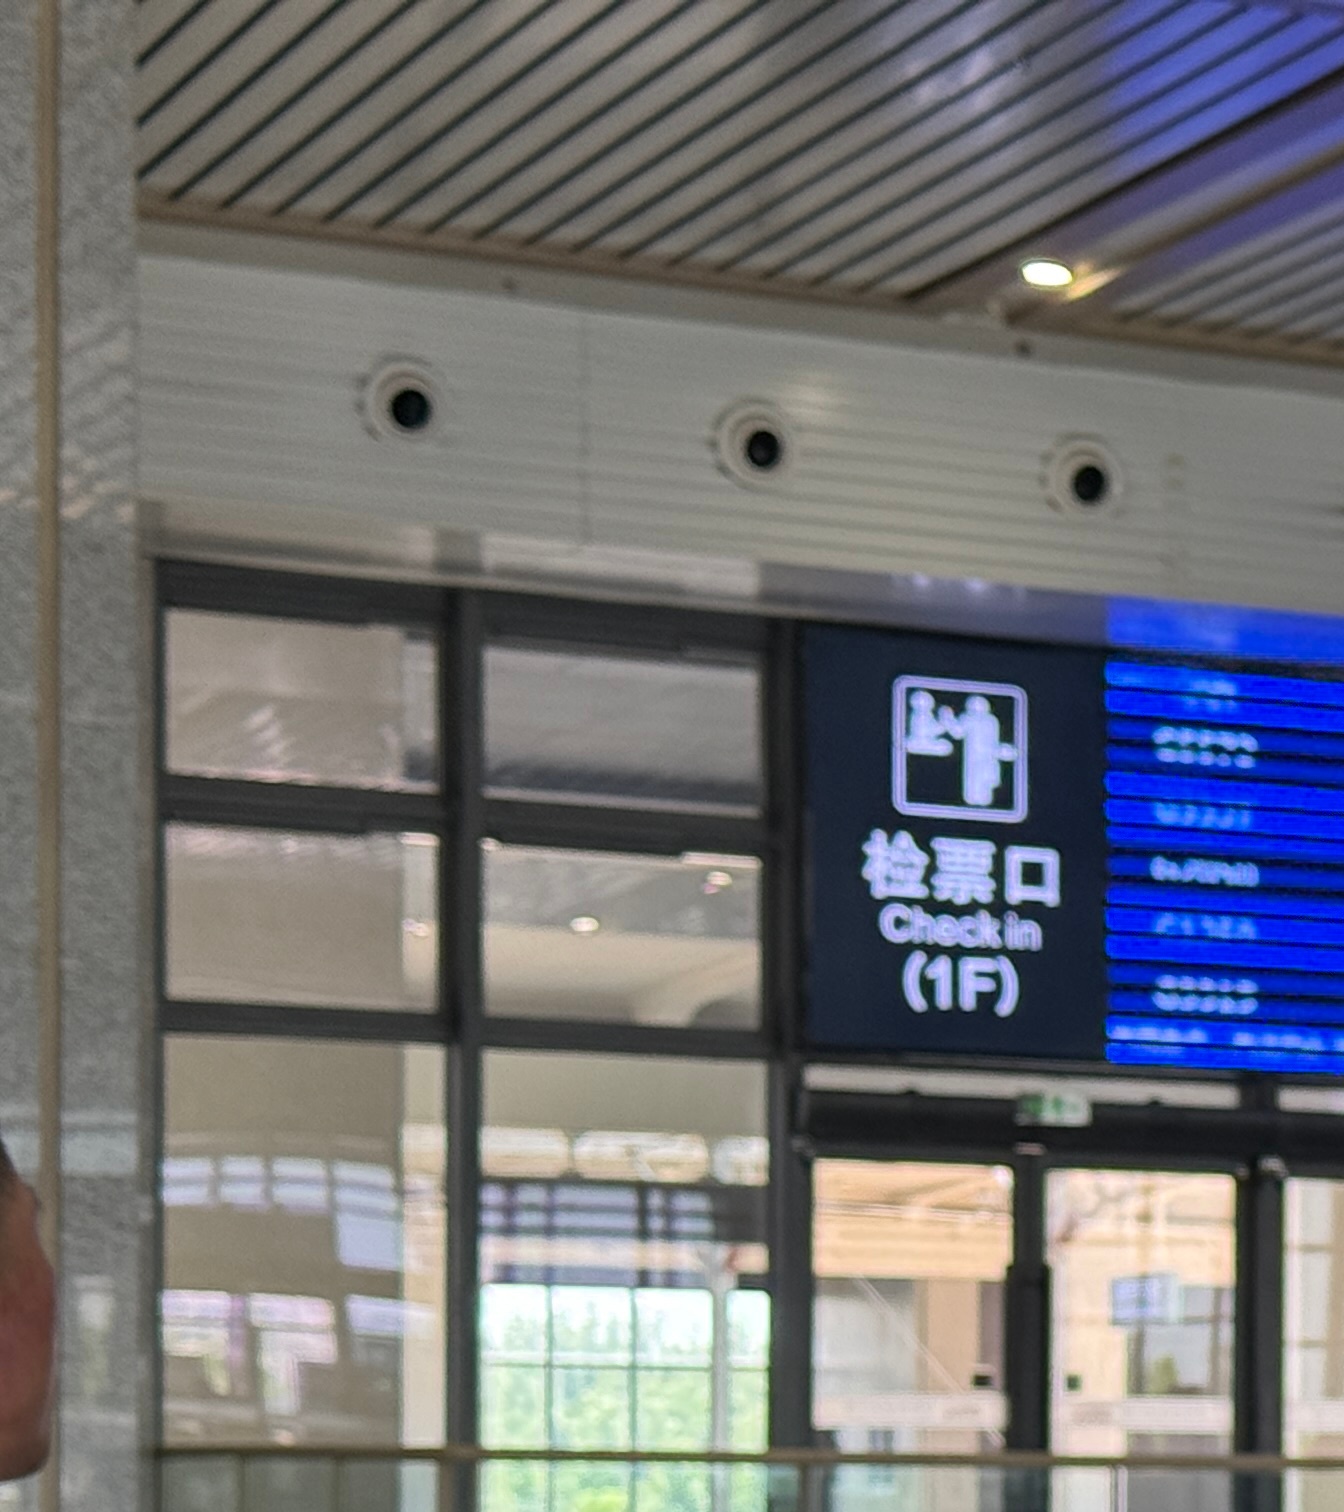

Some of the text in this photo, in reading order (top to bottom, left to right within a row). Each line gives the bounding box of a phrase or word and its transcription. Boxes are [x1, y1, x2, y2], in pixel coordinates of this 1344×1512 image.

[861, 828, 1060, 907] 检票口
[878, 903, 1043, 951] Check in
[903, 950, 1020, 1018] (1F)
